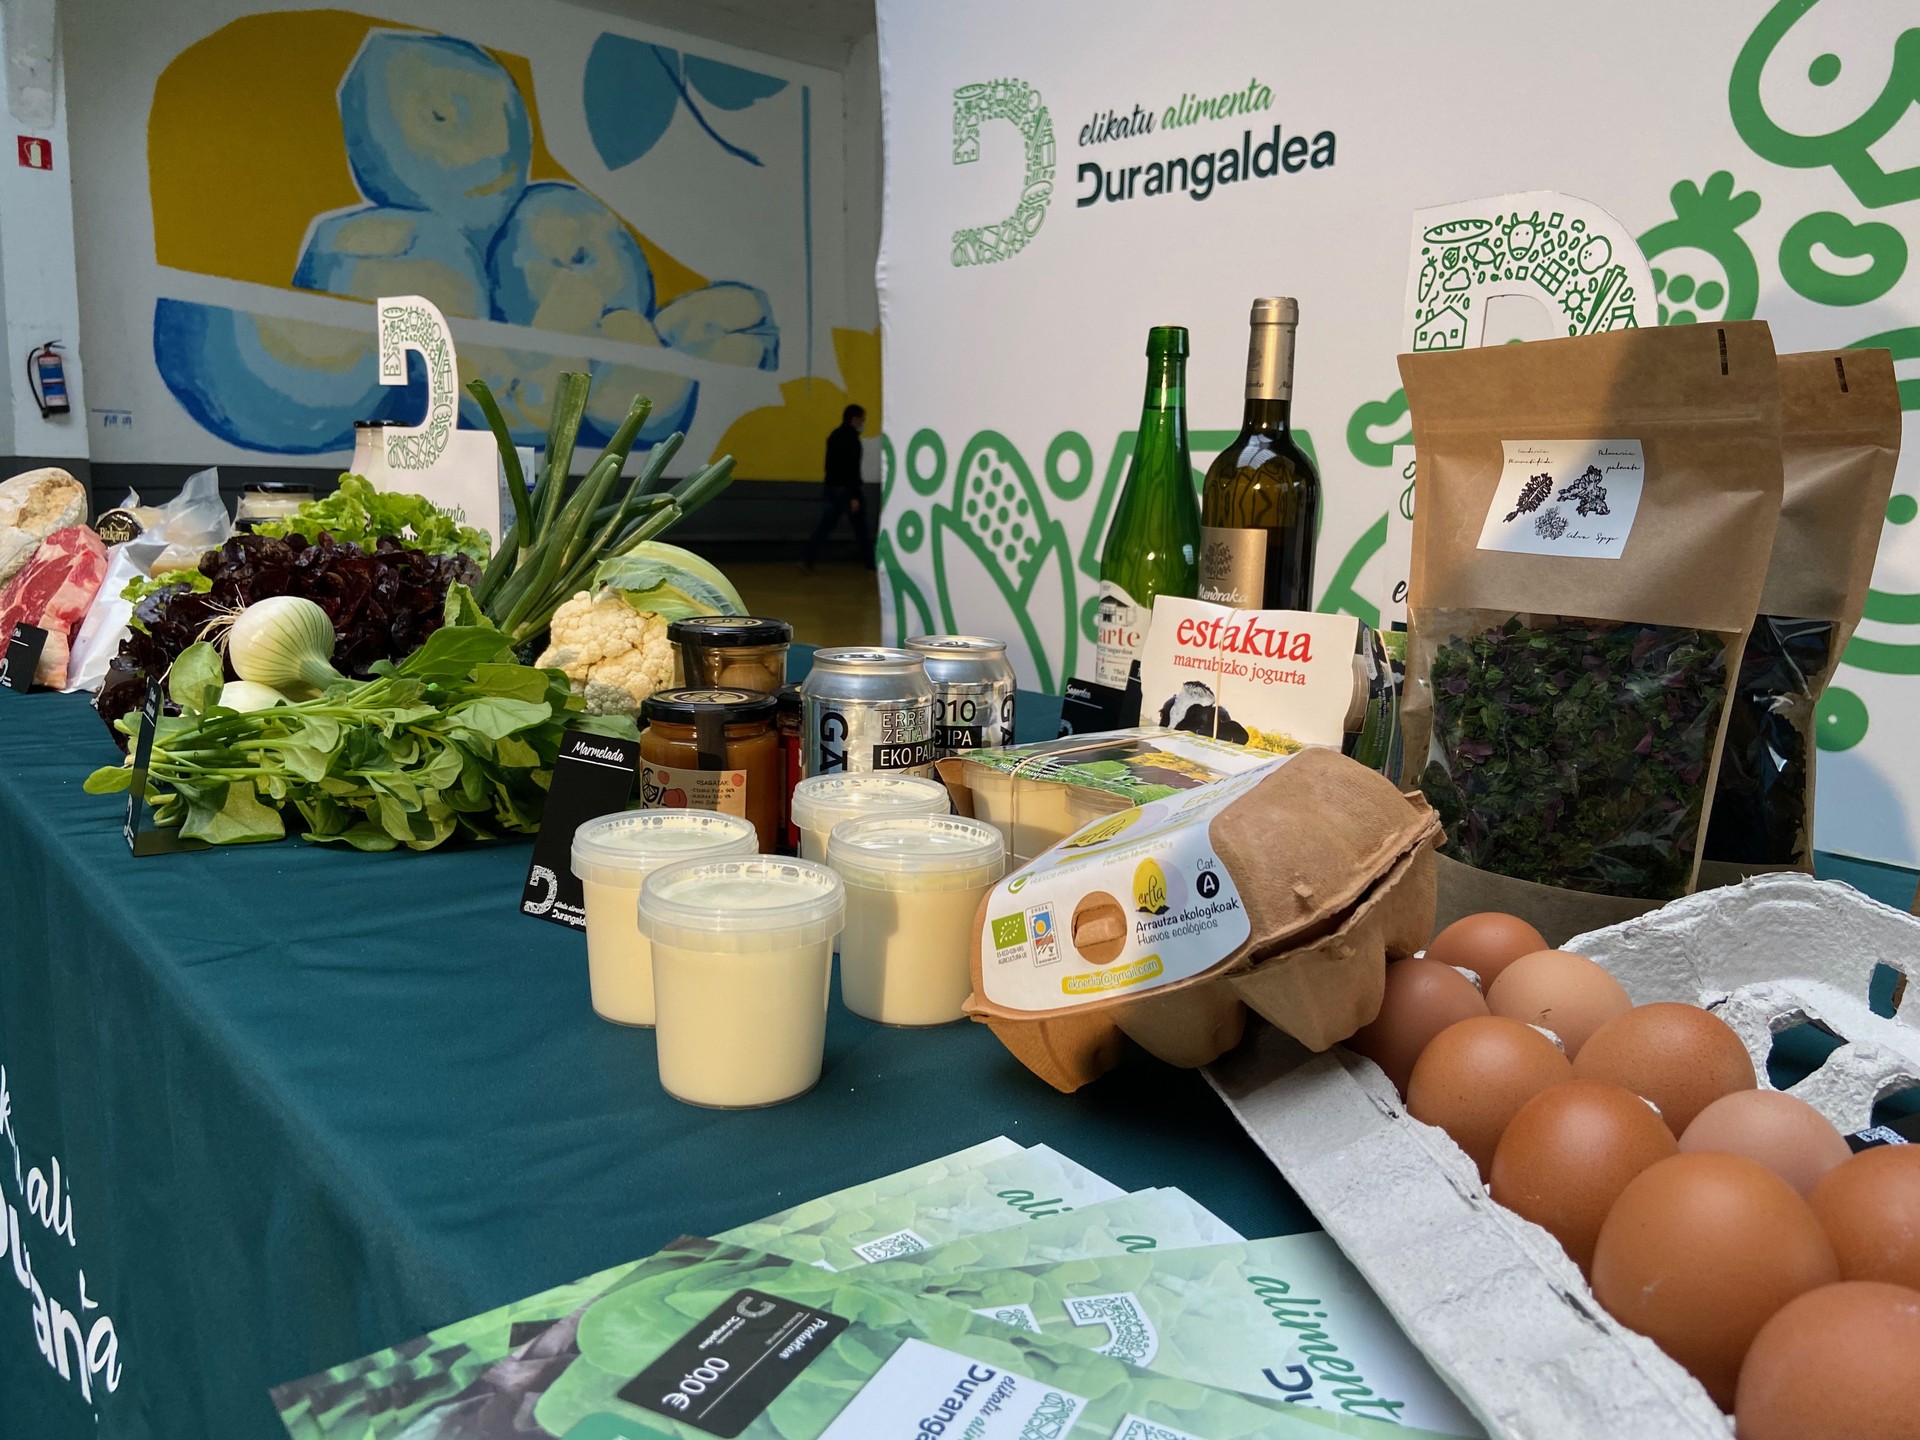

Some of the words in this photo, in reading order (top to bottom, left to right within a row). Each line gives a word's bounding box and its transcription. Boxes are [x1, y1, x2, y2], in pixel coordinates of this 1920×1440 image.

[1078, 103, 1157, 148] elikatu
[1161, 77, 1276, 131] alimenta
[1076, 124, 1337, 208] Durangaldea
[1176, 616, 1314, 664] estakua
[1173, 652, 1248, 677] marrubizko
[1249, 662, 1307, 687] jogurta
[882, 709, 927, 729] ERRE
[883, 727, 925, 745] ZETA
[947, 729, 973, 746] IPA
[571, 741, 625, 763] Marmelada
[880, 747, 912, 767] EKO
[1196, 859, 1217, 872] Cat.
[1203, 874, 1216, 893] A
[1135, 915, 1178, 934] Arrautza
[1180, 899, 1240, 923] ekologikoak
[1137, 932, 1170, 947] Huevos
[1172, 918, 1219, 937] ecológicos
[1067, 959, 1159, 991] ekoerlia@gmail.com
[778, 1316, 829, 1361] Produktua
[979, 1375, 1017, 1416] elikatu
